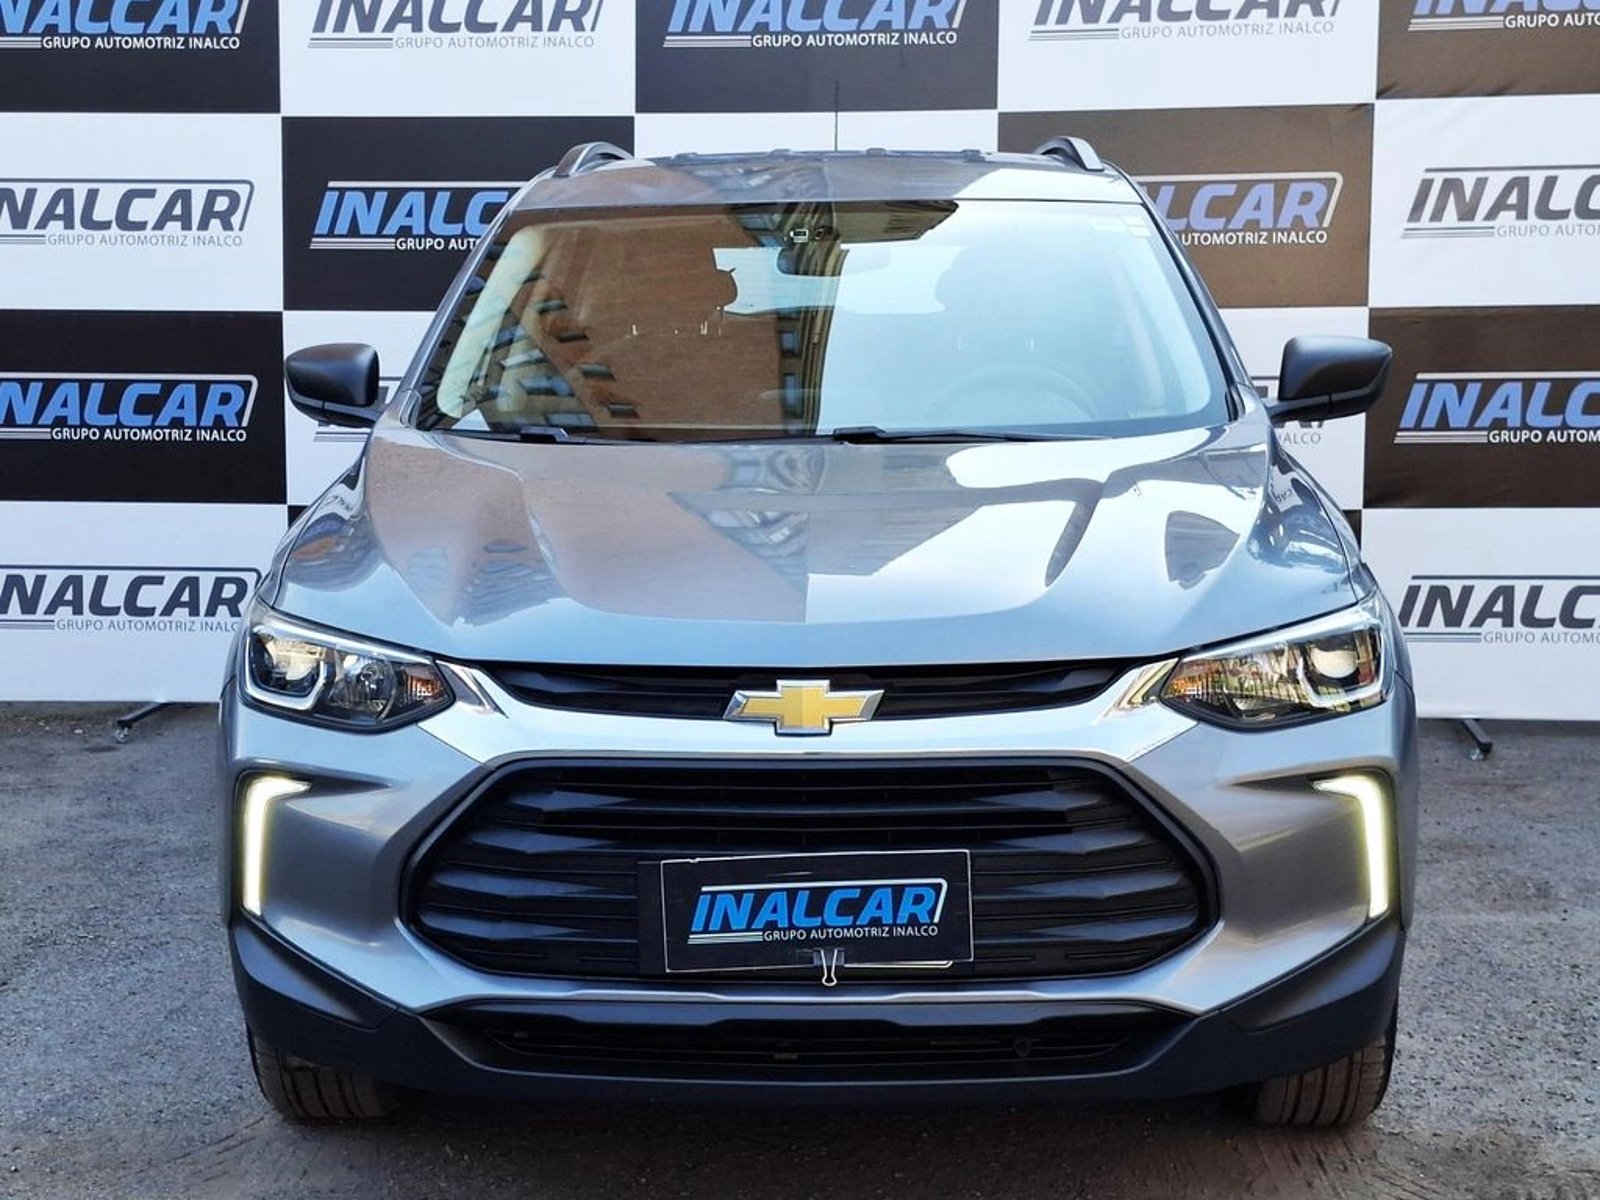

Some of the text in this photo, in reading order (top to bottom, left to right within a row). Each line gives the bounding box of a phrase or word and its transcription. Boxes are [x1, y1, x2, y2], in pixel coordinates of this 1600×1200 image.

[312, 0, 592, 33] INALCAR
[667, 0, 956, 33] INALCAR
[1505, 14, 1559, 28] GRUPO
[1121, 20, 1334, 39] GRUPO AUTOMOTRIZ INALCO
[43, 36, 240, 49] GRUPO AUTOMOTRIZ INALCO
[395, 36, 595, 49] GRUPO AUTOMOTRIZ INALCO
[752, 31, 957, 47] GRUPO AUTOMOTRIZ INALCO
[1143, 182, 1329, 231] LCAR
[1497, 223, 1600, 237] GRUPO AUTO
[47, 234, 243, 247] GRUPO AUTOMOTRIZ INALCO
[396, 237, 479, 250] GRUPO AUT
[1175, 230, 1328, 246] UTOMOTRIZ INALCO
[52, 427, 247, 441] GRUPO AUTOMOTRIZ INALCO
[1279, 432, 1321, 444] ALCO
[1489, 430, 1542, 443] GRUPO
[1398, 585, 1600, 629] INALC
[57, 619, 103, 631] GRUPO
[108, 620, 195, 632] AUTOMOTRIZ
[1483, 631, 1535, 644] GRUPO
[691, 887, 936, 931] INALCAR
[763, 925, 938, 941] GRUPO AUTOMOTRIZ INALCO
